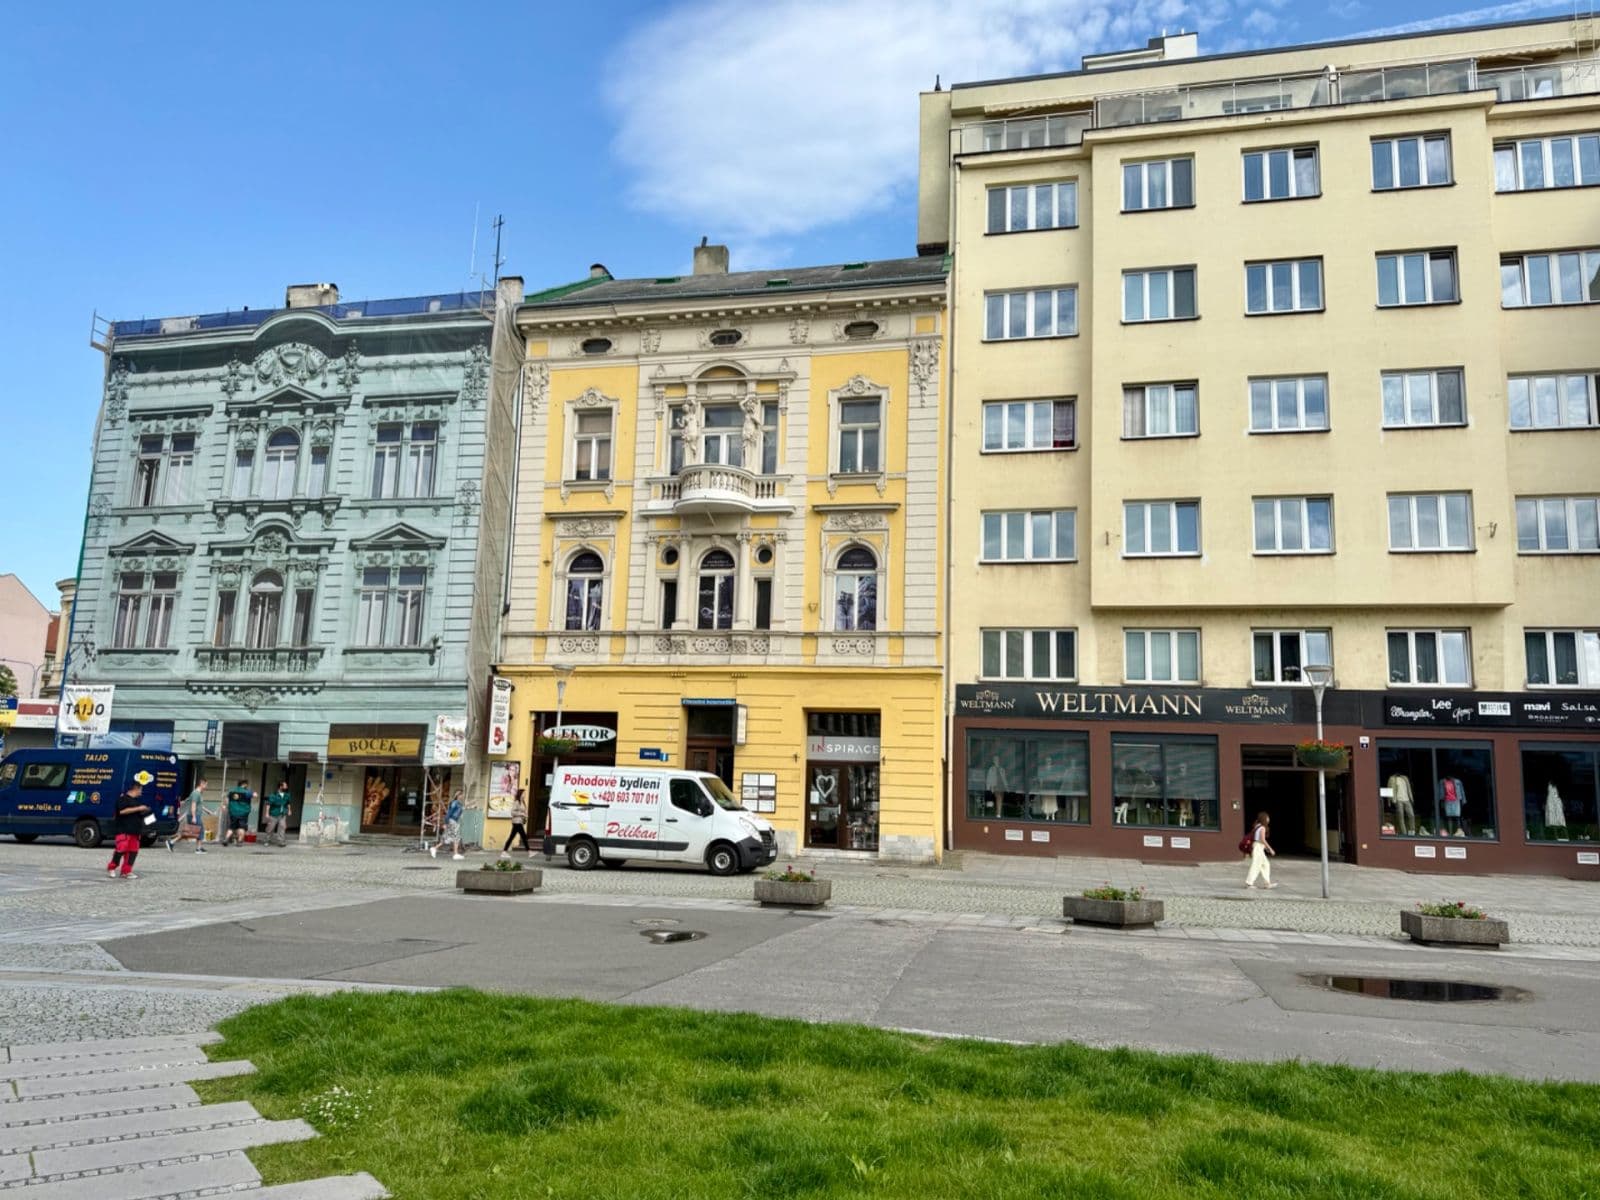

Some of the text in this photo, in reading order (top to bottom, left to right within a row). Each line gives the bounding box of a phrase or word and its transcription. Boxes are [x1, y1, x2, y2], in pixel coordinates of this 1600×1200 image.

[66, 703, 105, 715] TAIJO
[960, 699, 1016, 709] WELTMANN
[1035, 692, 1203, 715] WELTMANN
[1431, 699, 1452, 709] Lee
[1523, 702, 1551, 710] mavi
[1225, 704, 1287, 715] WELTMANN
[811, 741, 880, 754] INSPIRACE
[564, 774, 617, 787] Pohodové
[632, 793, 644, 803] 707
[646, 793, 658, 804] 011
[607, 821, 657, 839] Pelikan
